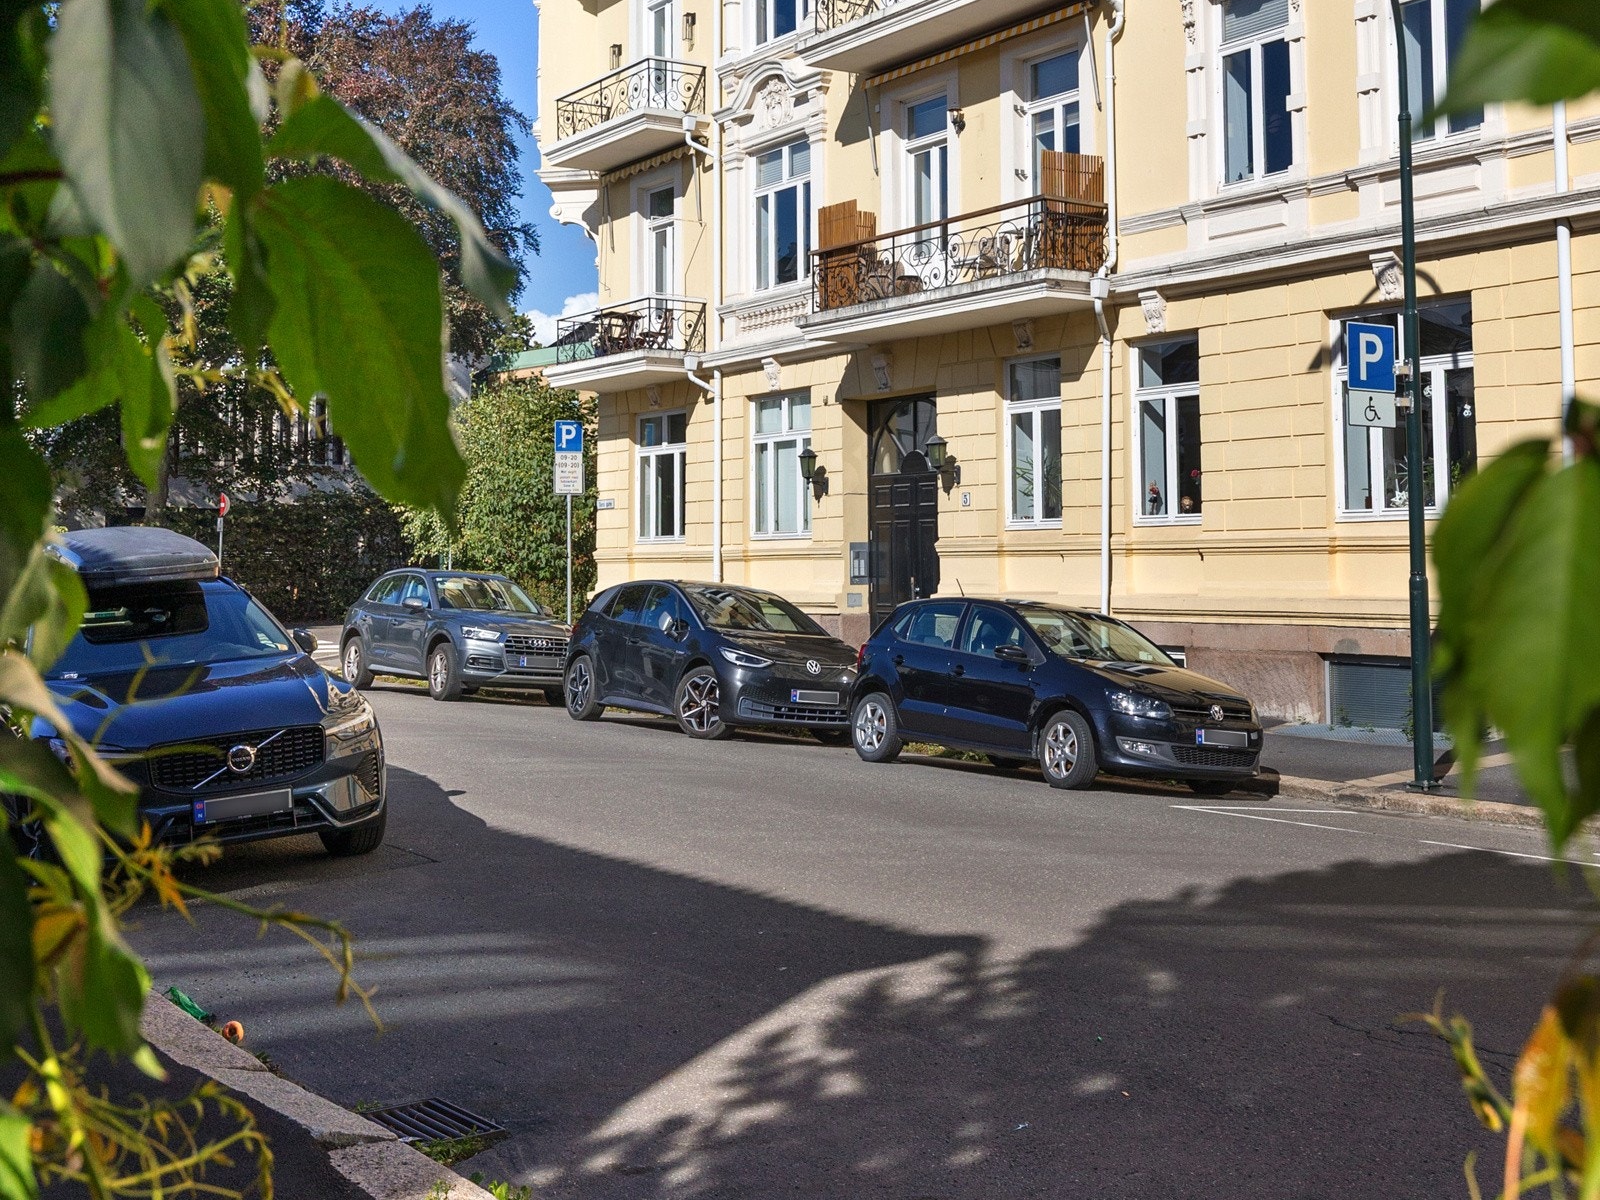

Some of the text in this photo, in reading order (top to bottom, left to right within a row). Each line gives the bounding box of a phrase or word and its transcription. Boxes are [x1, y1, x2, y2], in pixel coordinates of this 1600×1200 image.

[1359, 332, 1384, 381] P
[561, 424, 577, 448] P
[963, 494, 969, 505] 5
